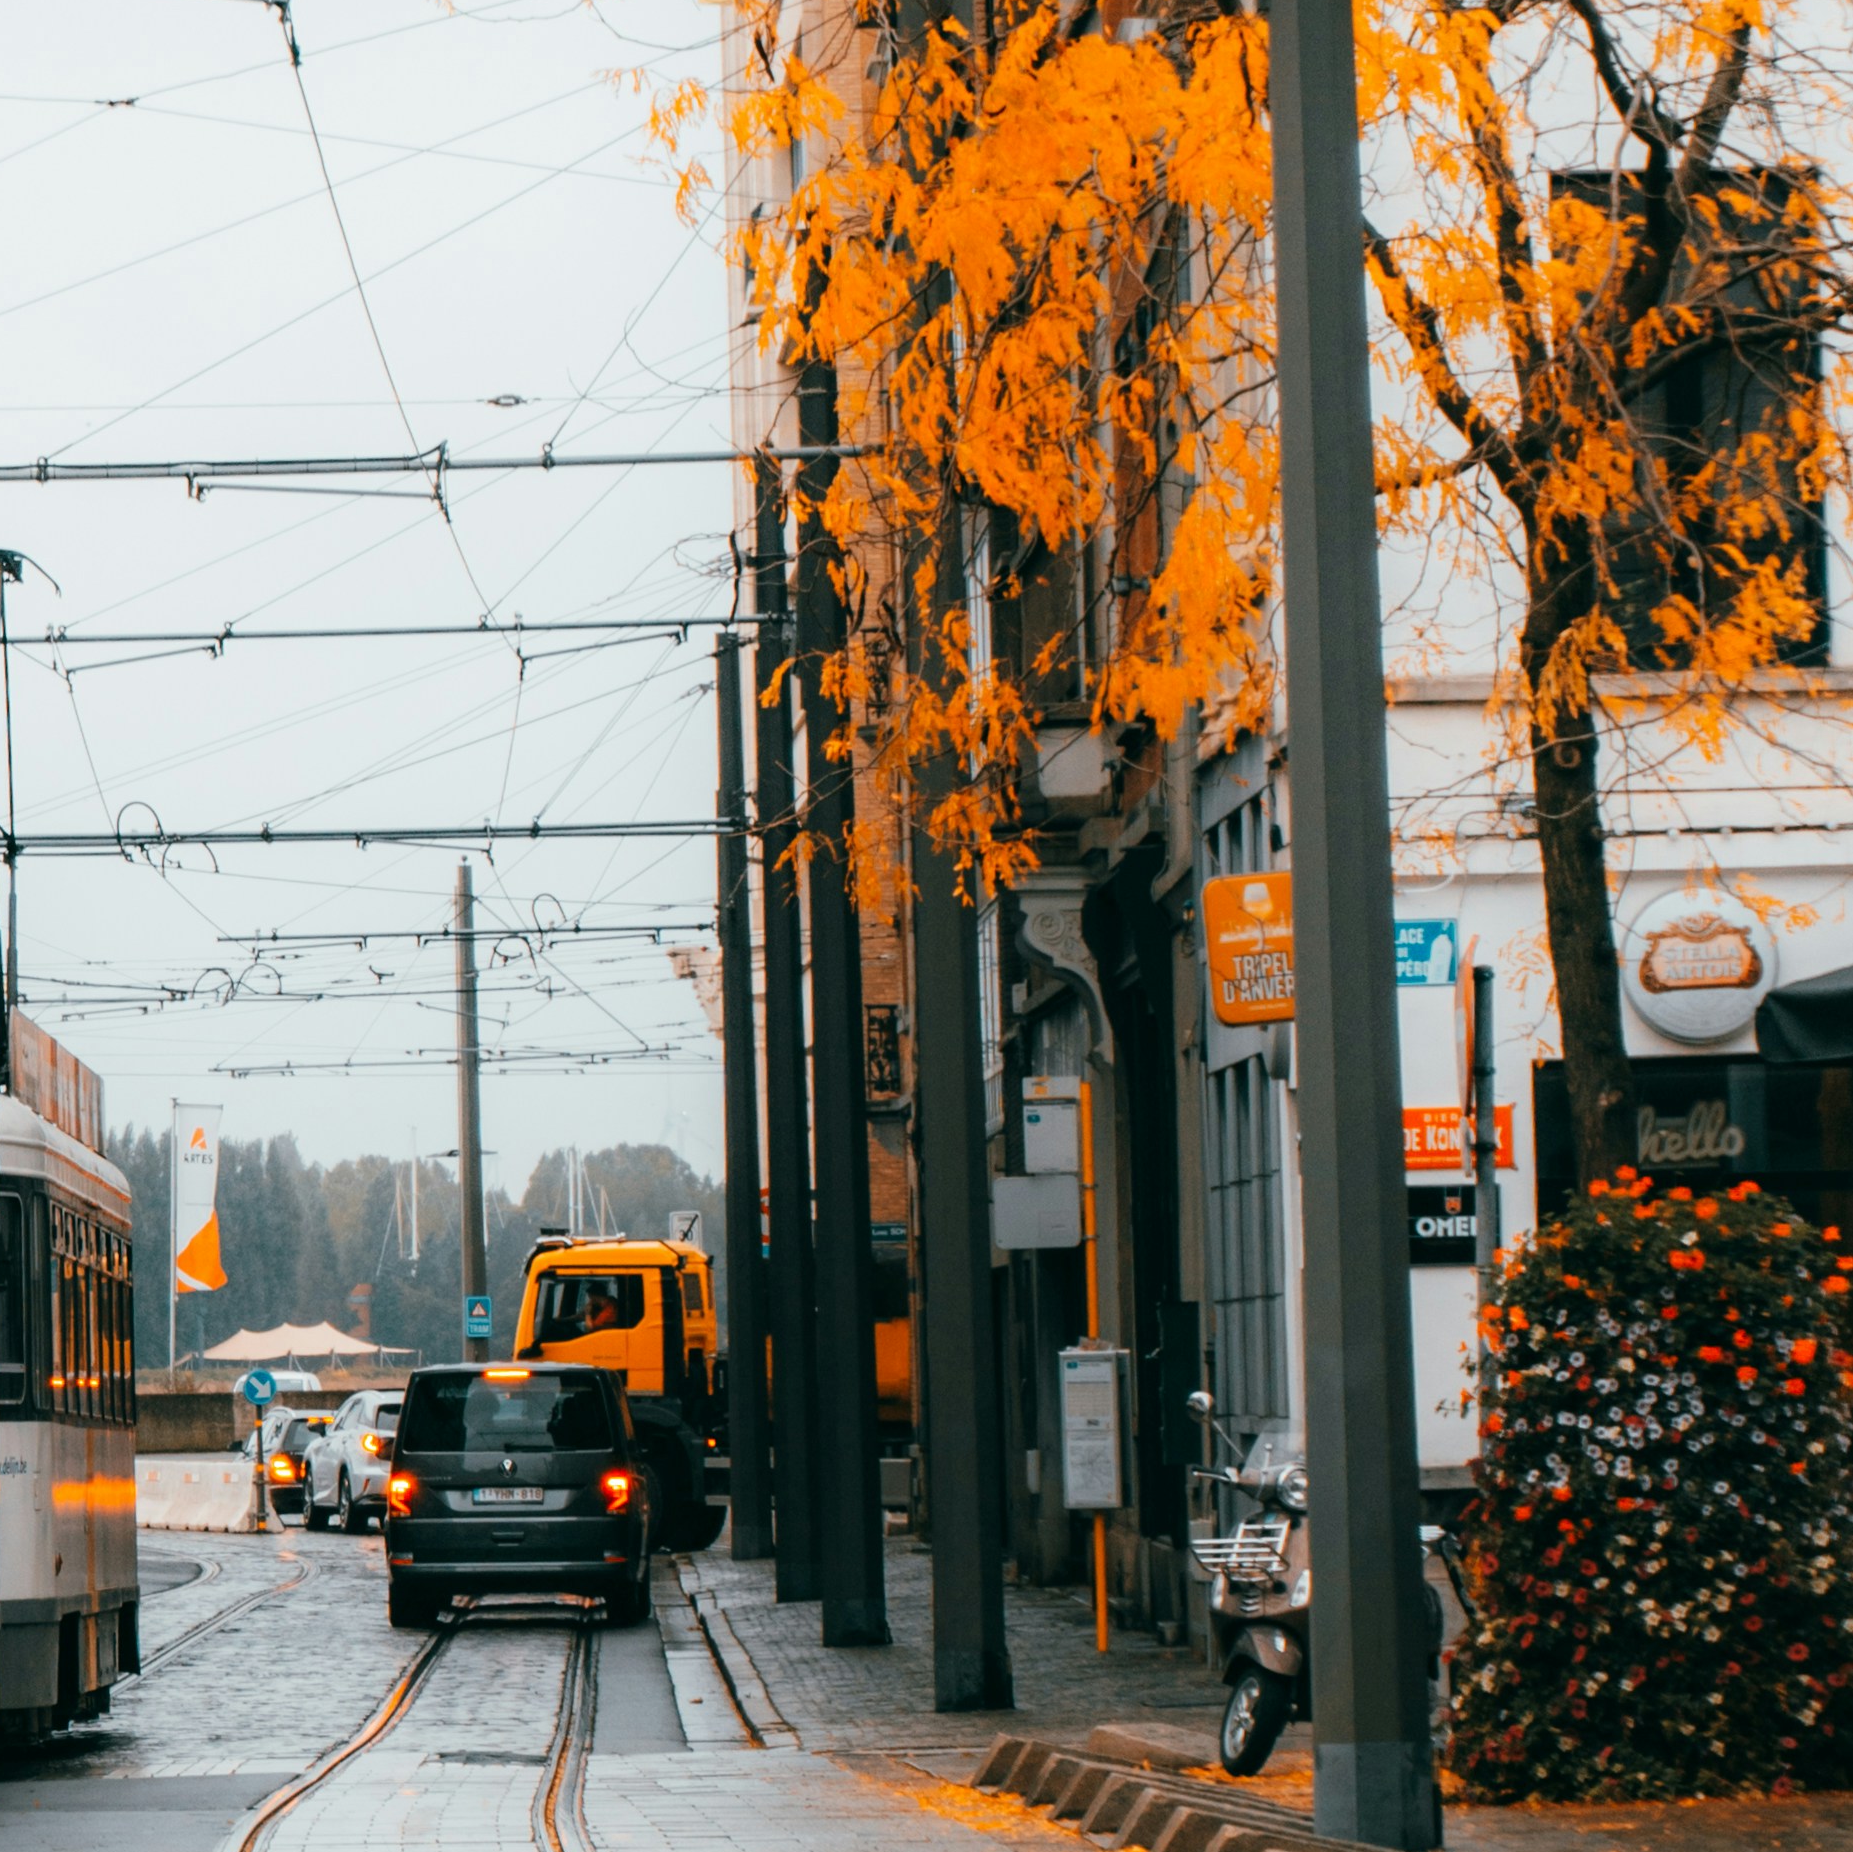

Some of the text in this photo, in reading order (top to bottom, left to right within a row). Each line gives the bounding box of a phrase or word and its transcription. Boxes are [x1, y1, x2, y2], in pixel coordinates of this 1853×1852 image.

[1662, 944, 1740, 961] STELLA
[1232, 951, 1293, 981] TRIPEL
[1665, 962, 1741, 981] ARTOIS
[1637, 1098, 1745, 1164] hello
